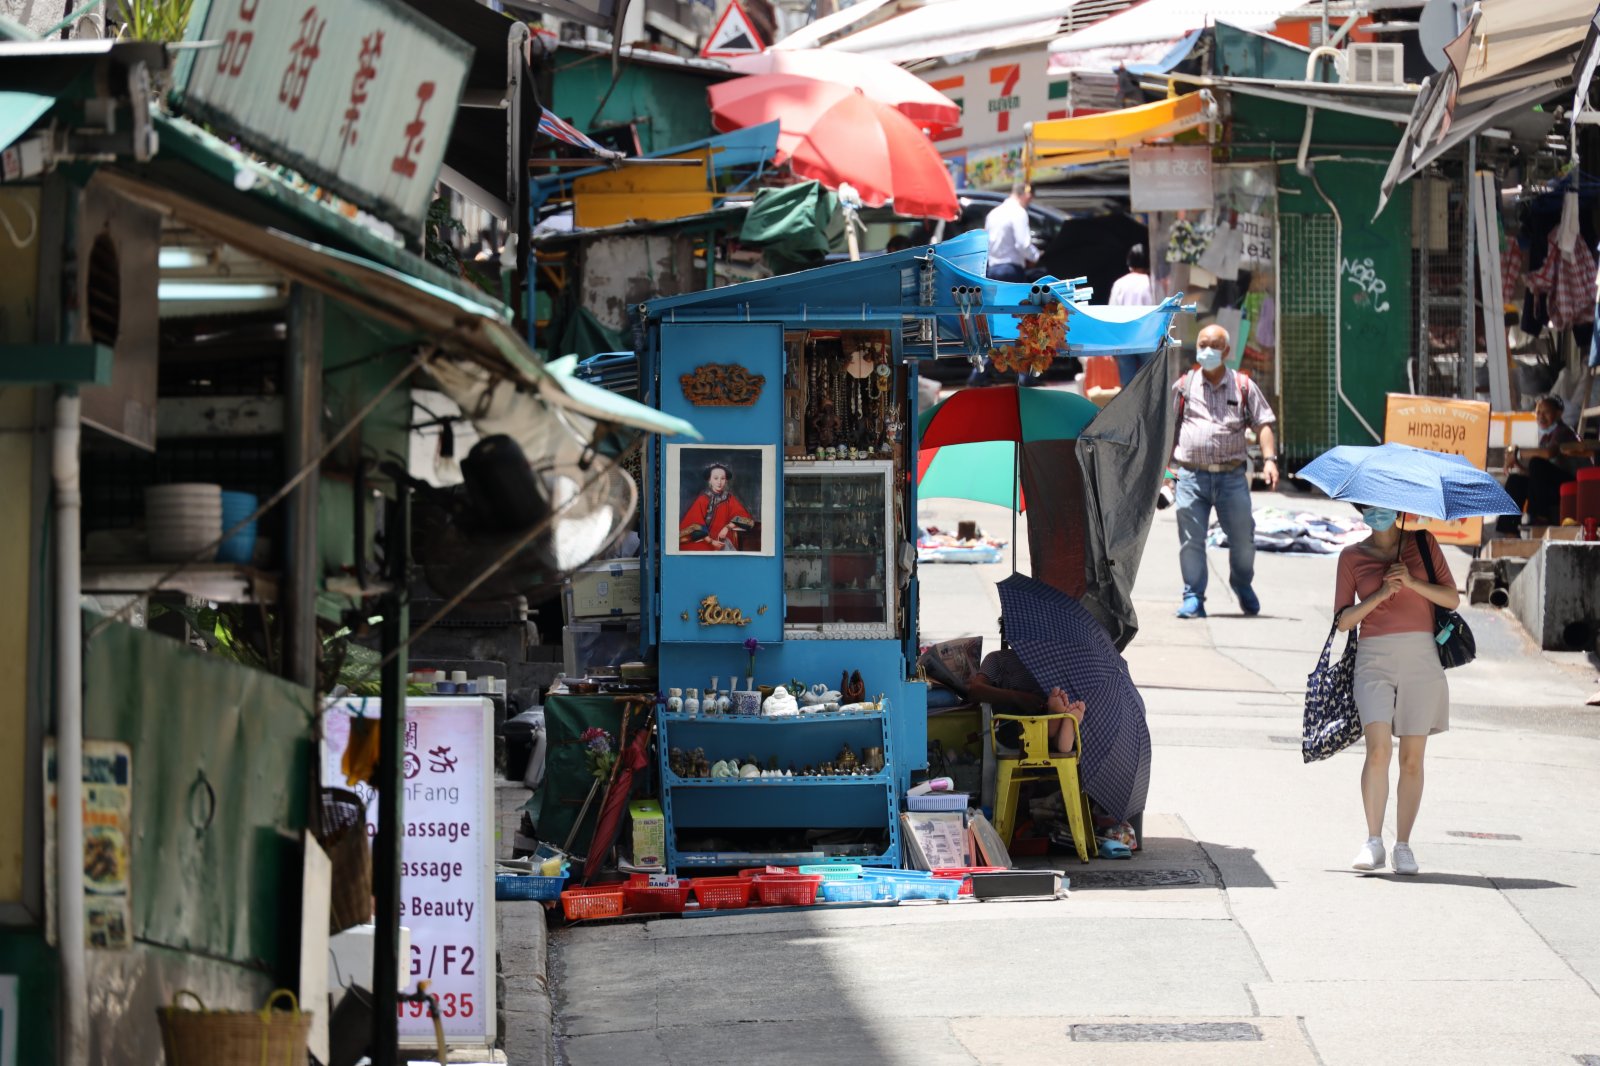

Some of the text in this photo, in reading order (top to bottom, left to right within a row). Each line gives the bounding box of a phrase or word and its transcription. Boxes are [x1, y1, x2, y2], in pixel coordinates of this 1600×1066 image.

[989, 63, 1021, 132] 7
[402, 821, 470, 843] assage
[400, 861, 463, 883] assage
[411, 896, 474, 923] Beauty
